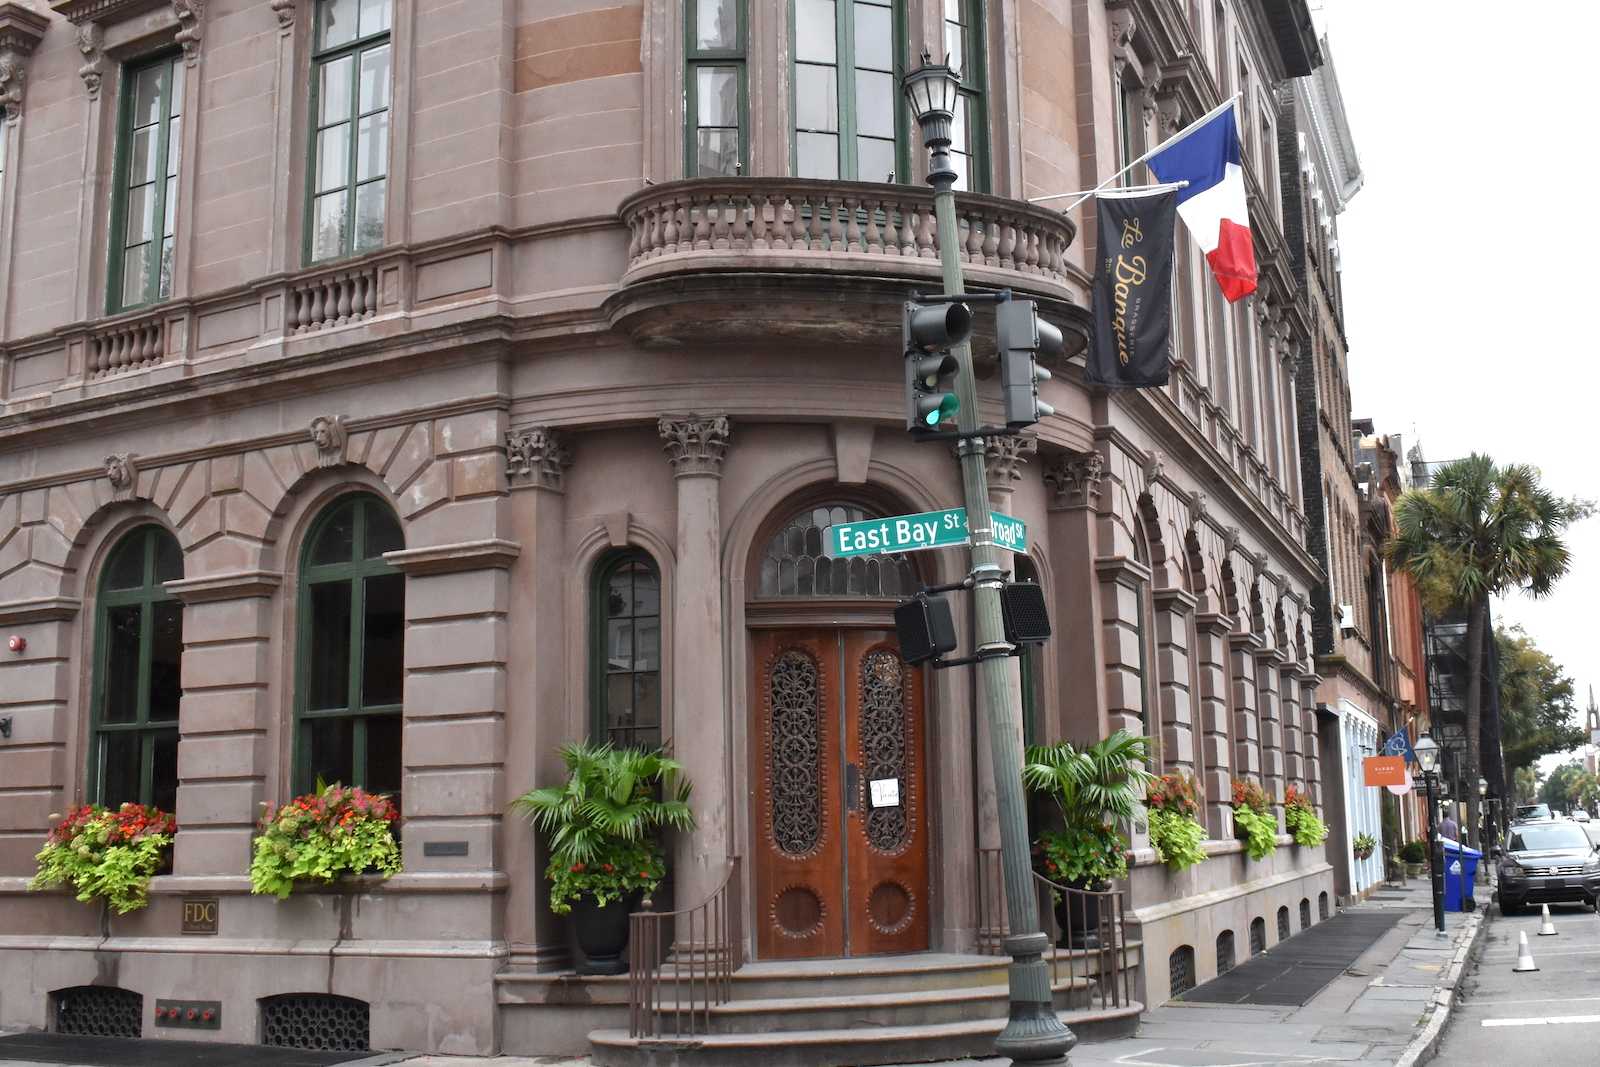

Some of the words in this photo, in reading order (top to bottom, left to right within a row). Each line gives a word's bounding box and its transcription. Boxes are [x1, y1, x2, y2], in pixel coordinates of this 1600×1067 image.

[1121, 217, 1143, 249] La
[1112, 254, 1146, 367] Banque
[839, 523, 890, 552] East
[896, 520, 938, 544] Bay
[944, 513, 960, 530] St
[1015, 522, 1024, 539] St
[184, 903, 216, 922] FDC
